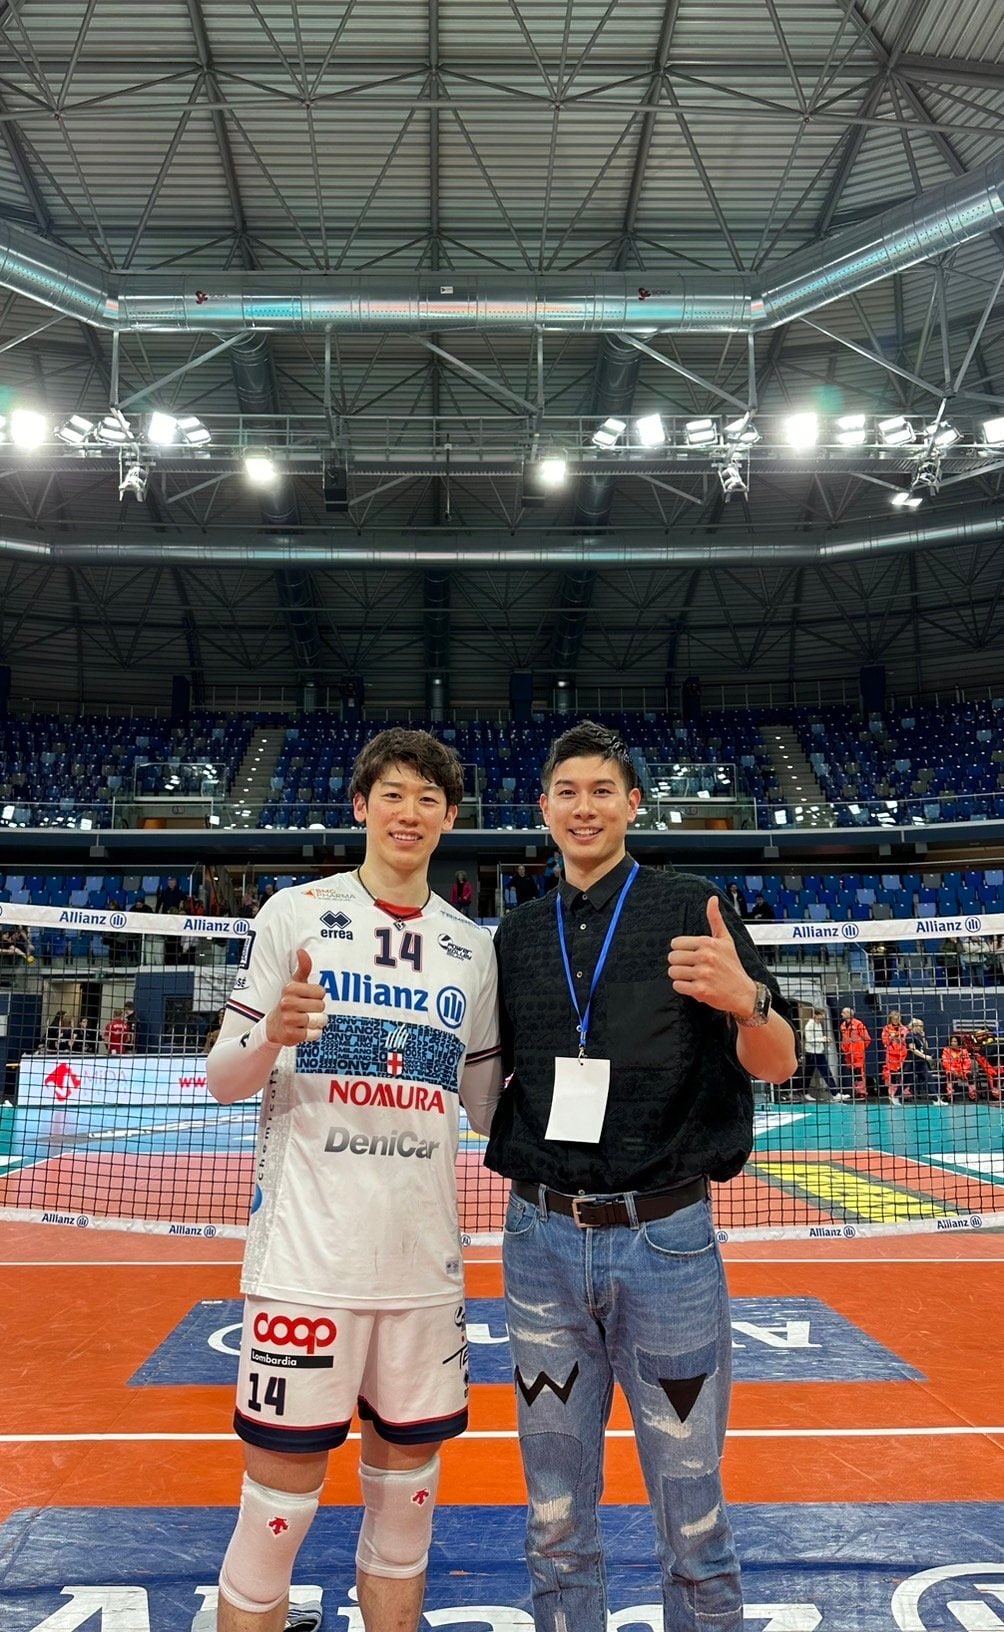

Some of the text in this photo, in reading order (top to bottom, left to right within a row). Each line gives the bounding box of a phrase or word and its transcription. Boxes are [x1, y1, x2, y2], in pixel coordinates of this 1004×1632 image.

[59, 910, 107, 925] Allianz
[183, 918, 230, 932] Allianz
[792, 926, 839, 938] Allianz
[916, 920, 962, 933] Allianz
[374, 926, 423, 973] 14
[319, 970, 429, 1012] Allianz
[328, 1079, 445, 1114] NOMURA
[324, 1126, 442, 1160] DeniCar
[41, 1212, 75, 1225] Allianz
[936, 1218, 969, 1230] Allianz
[168, 1224, 202, 1236] Allianz
[808, 1227, 842, 1238] Allianz
[253, 1311, 337, 1355] coop
[251, 1350, 298, 1367] Lombardia
[248, 1372, 286, 1416] 14
